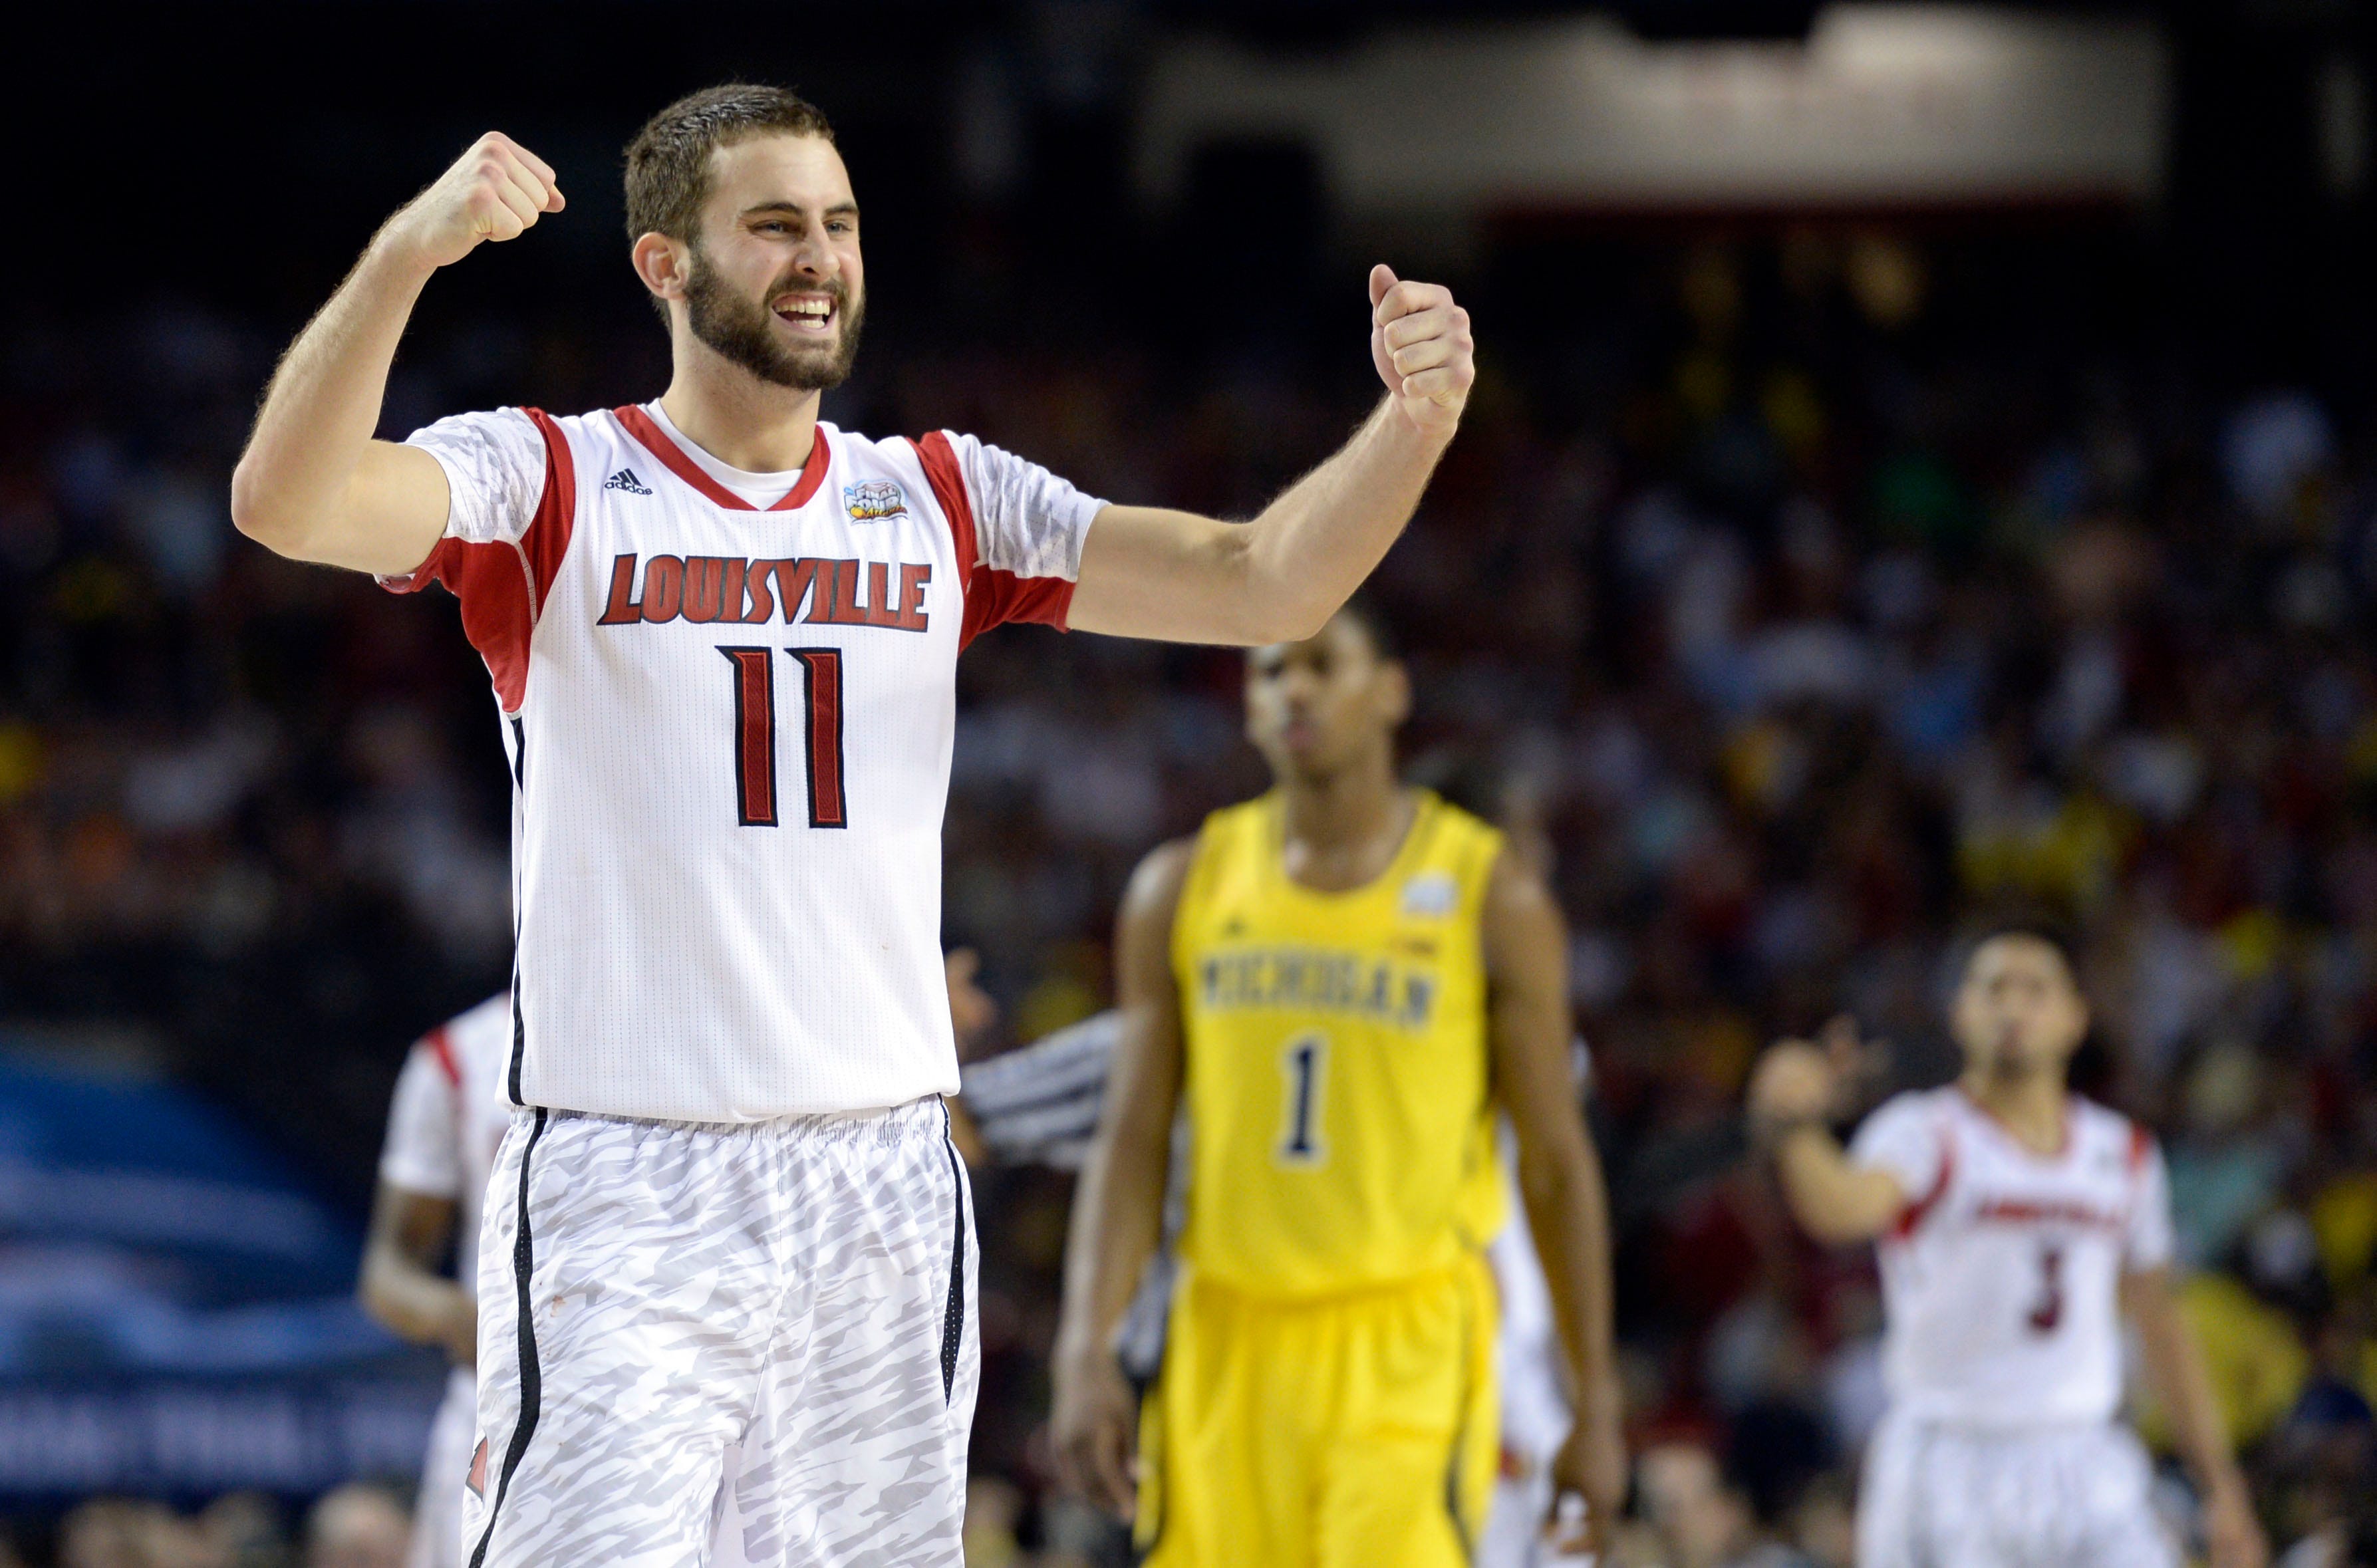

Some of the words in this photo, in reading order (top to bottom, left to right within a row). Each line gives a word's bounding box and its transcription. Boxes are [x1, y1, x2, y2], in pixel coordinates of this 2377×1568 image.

[604, 481, 653, 495] adidas
[844, 495, 901, 511] FOUR
[596, 553, 932, 632] LOUISVILLE
[714, 645, 848, 829] 11
[1282, 1037, 1326, 1161] 1
